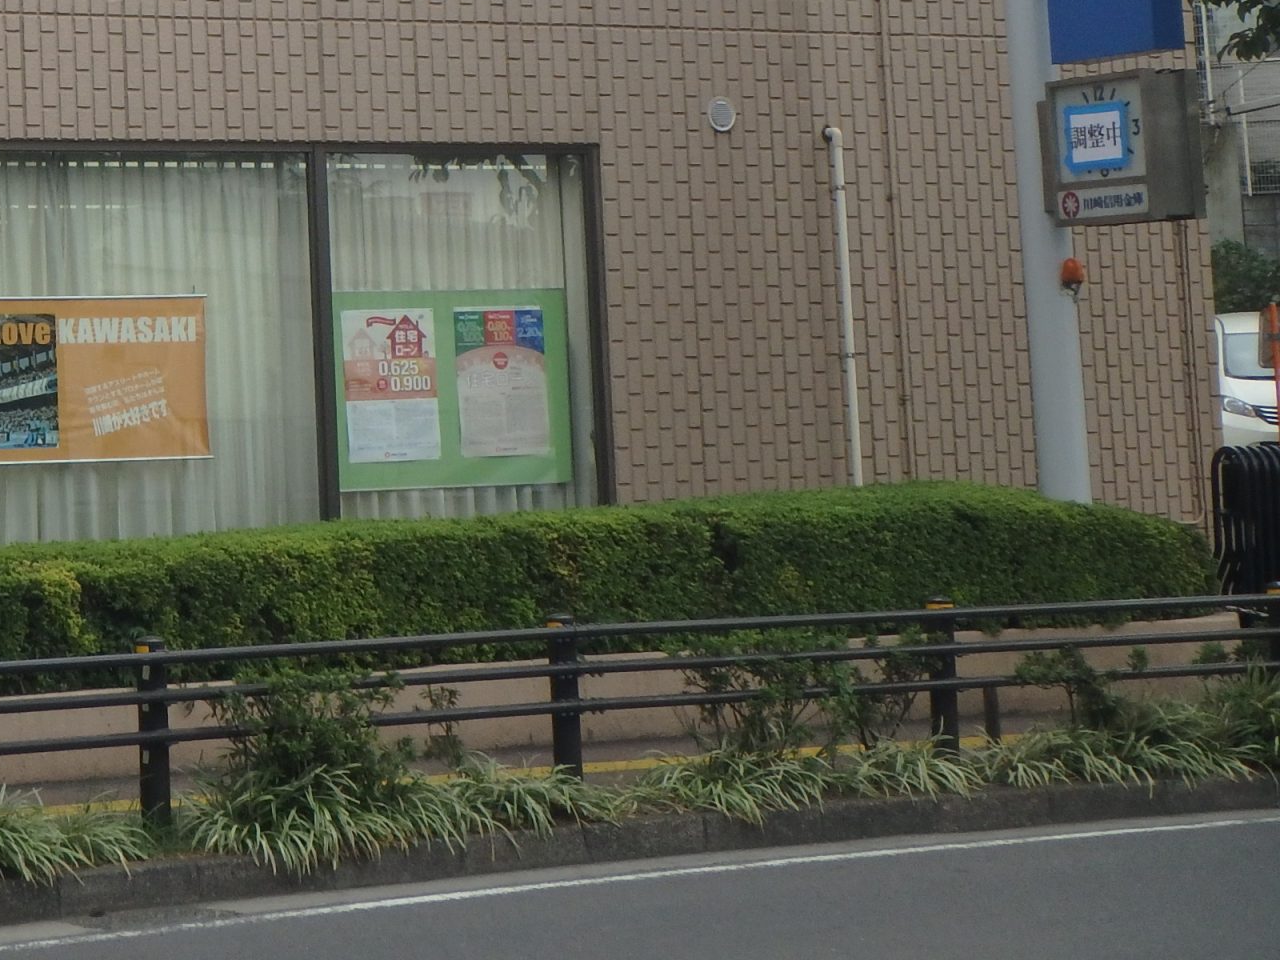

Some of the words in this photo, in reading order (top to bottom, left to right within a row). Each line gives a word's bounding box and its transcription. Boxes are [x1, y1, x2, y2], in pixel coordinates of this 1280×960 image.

[1072, 121, 1122, 150] 調整中
[59, 316, 197, 345] KAWASAKI
